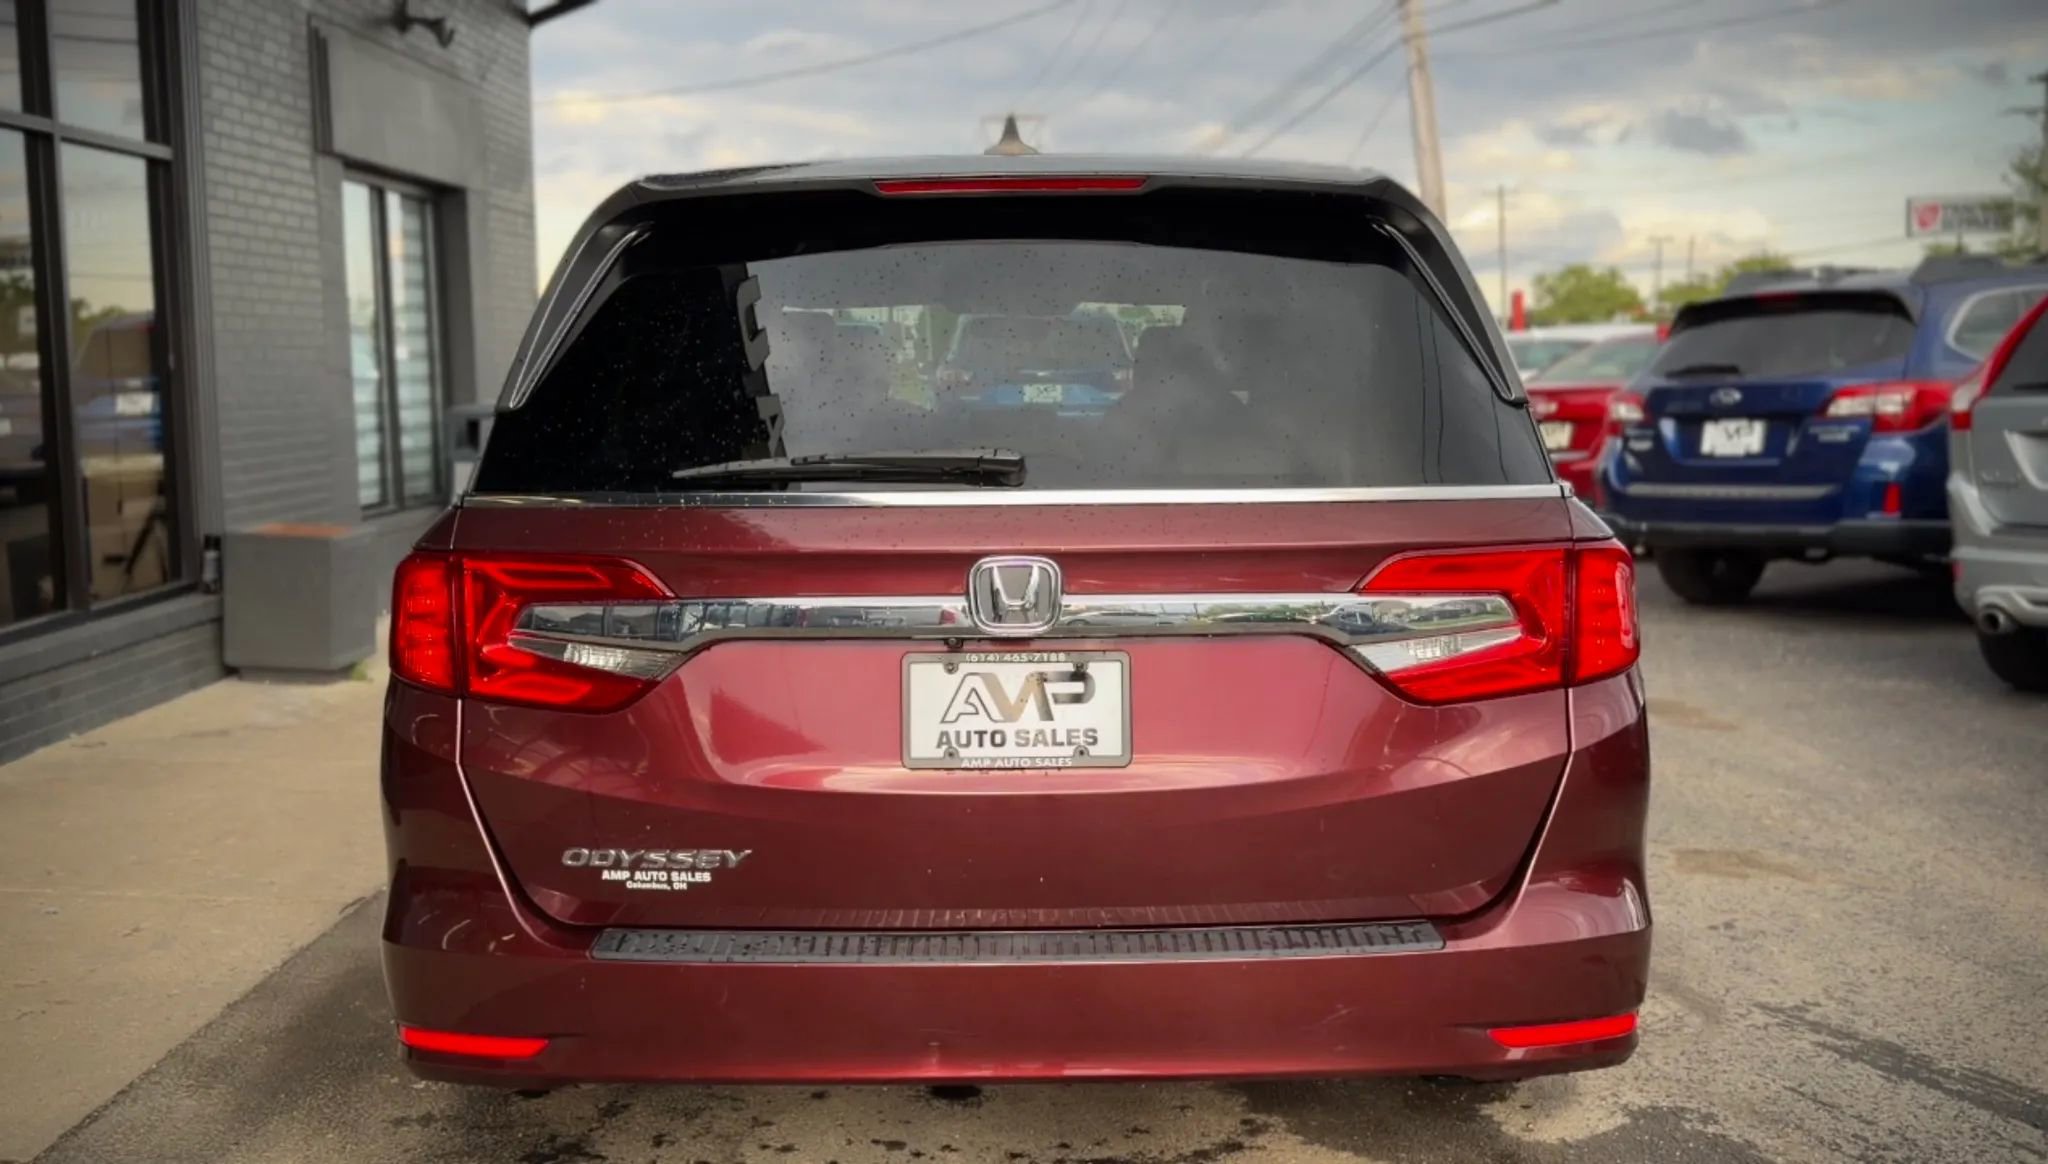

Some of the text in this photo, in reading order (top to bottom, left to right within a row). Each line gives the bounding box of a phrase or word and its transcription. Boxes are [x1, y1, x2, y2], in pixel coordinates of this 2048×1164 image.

[940, 671, 1096, 723] AMP
[936, 728, 1099, 749] AUTO SALES
[961, 757, 1073, 768] AMP AUTO SALES
[561, 848, 753, 869] ODYSSEY
[601, 870, 712, 883] AMP AUTO SALES
[673, 882, 688, 891] OH
